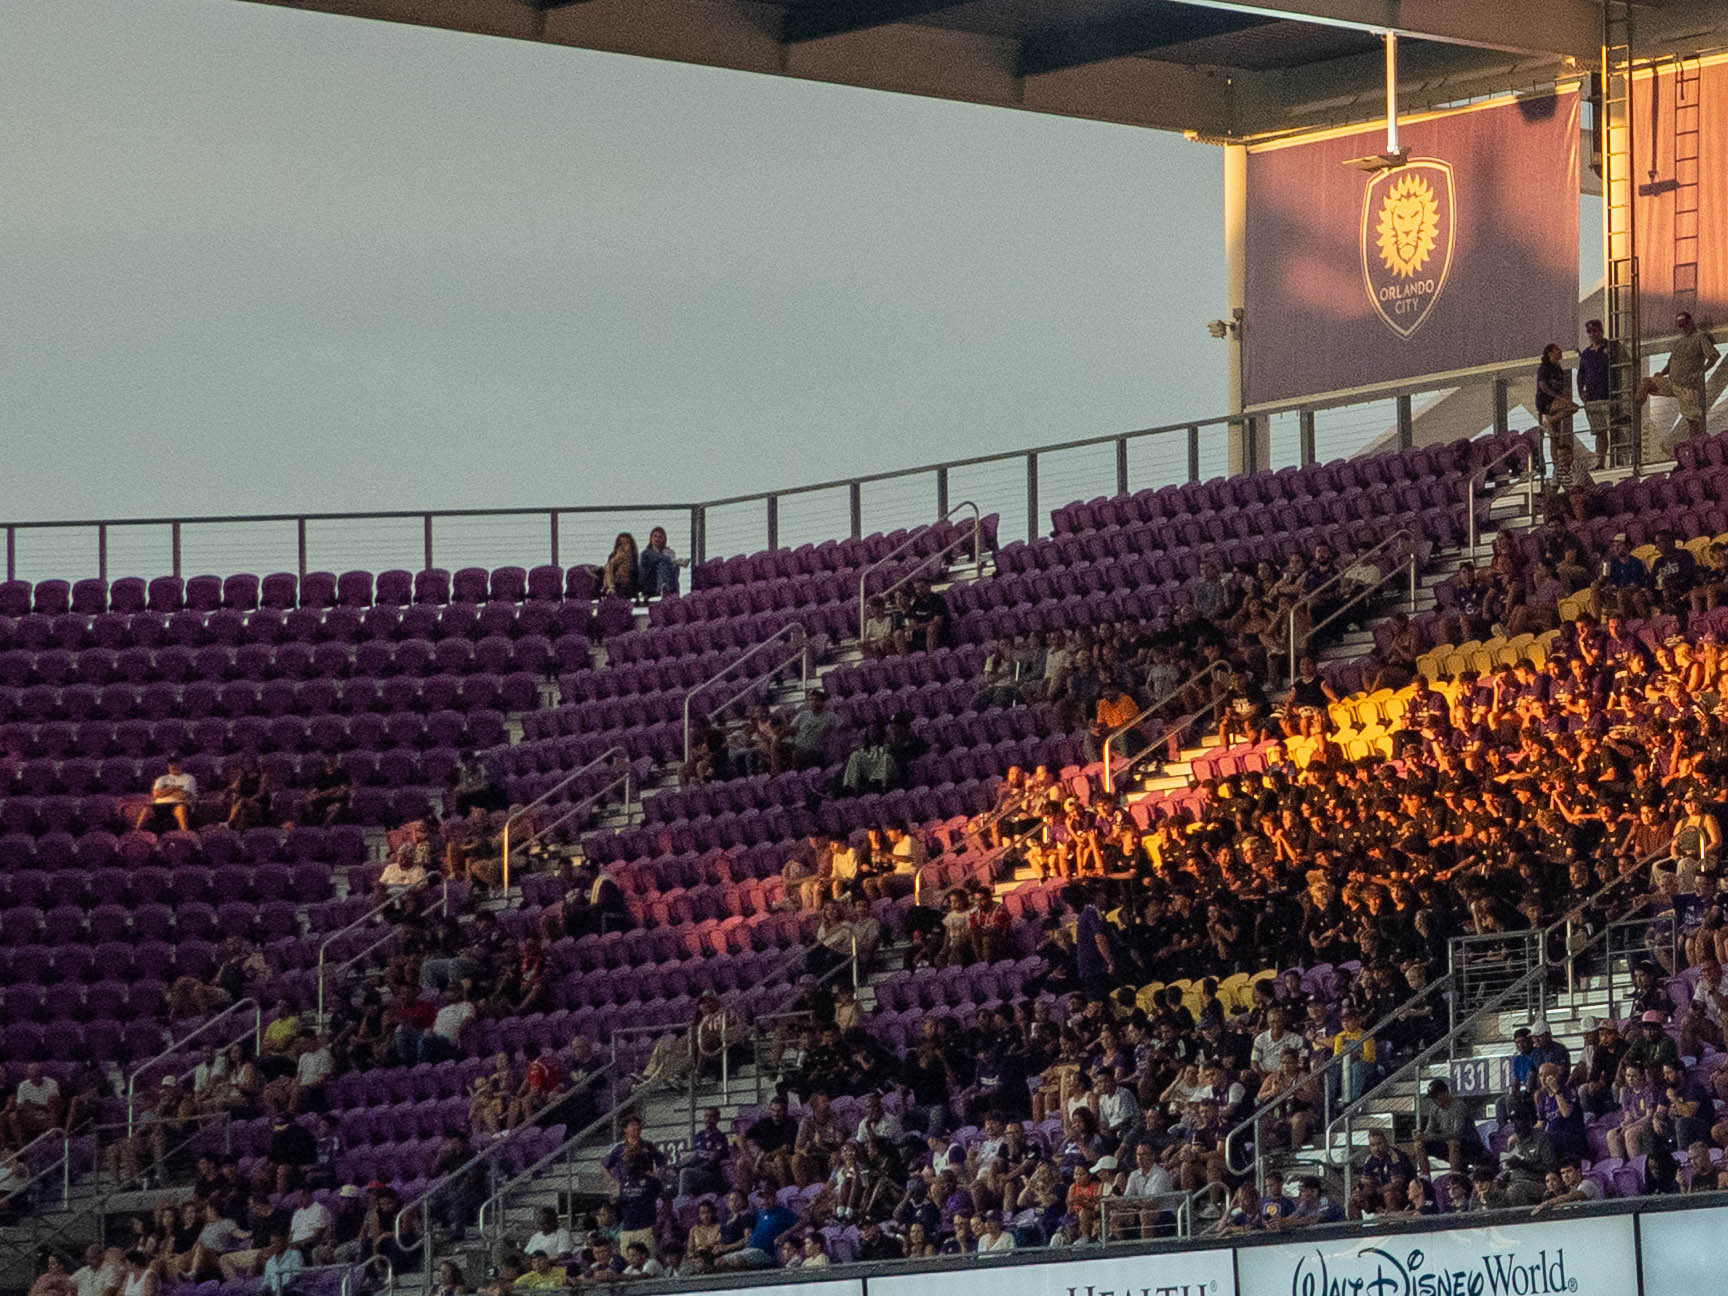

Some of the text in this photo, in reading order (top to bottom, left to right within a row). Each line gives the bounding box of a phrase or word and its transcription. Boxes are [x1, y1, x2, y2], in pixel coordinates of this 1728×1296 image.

[1379, 277, 1437, 303] ORLANDO
[1394, 296, 1422, 313] CITY
[1453, 1060, 1488, 1092] 131
